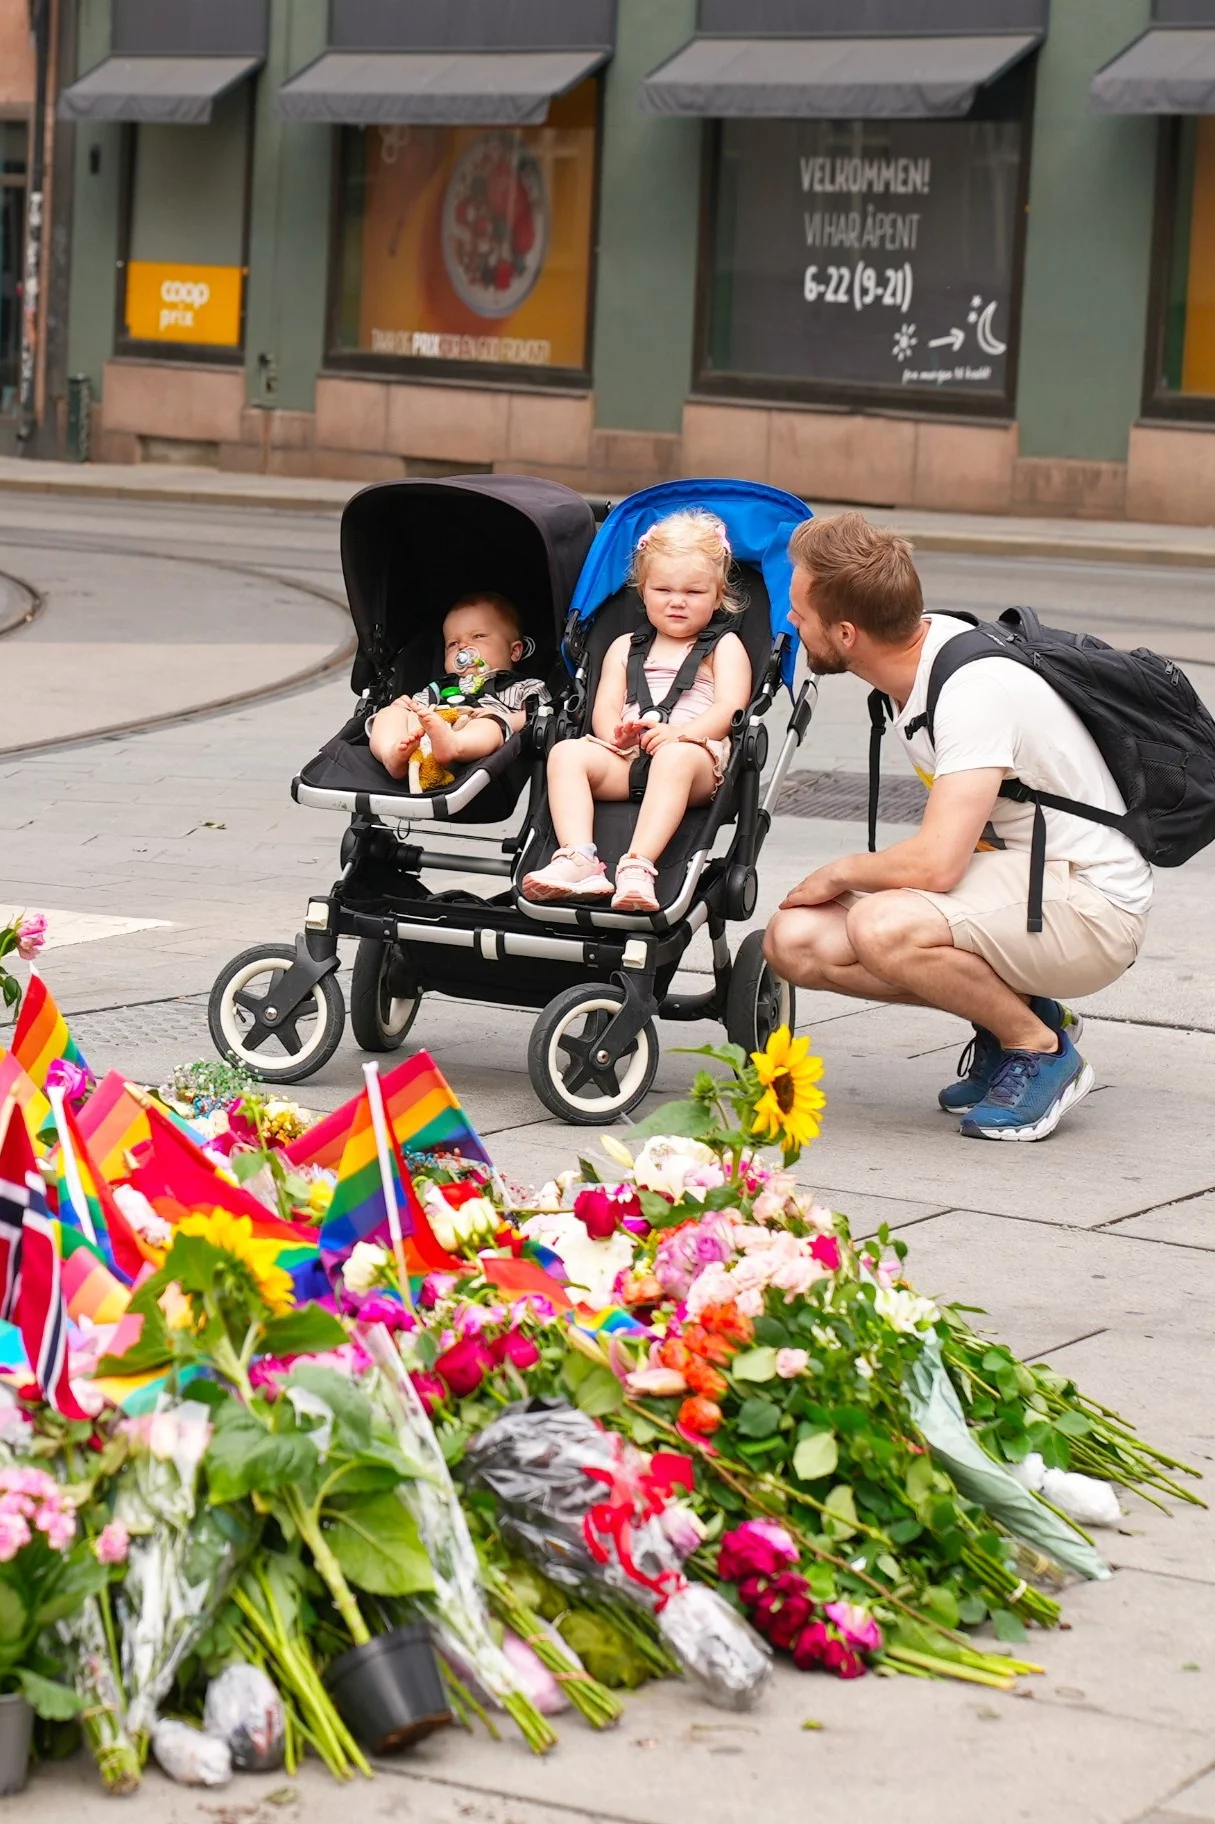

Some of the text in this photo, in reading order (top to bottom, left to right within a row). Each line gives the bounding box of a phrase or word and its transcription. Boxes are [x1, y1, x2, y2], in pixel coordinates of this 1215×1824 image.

[799, 156, 932, 195] VELKOMMEN!
[864, 203, 921, 250] ÅPENT
[160, 280, 211, 310] coop
[803, 260, 914, 314] 6-22 (9-21)
[159, 307, 195, 332] prix
